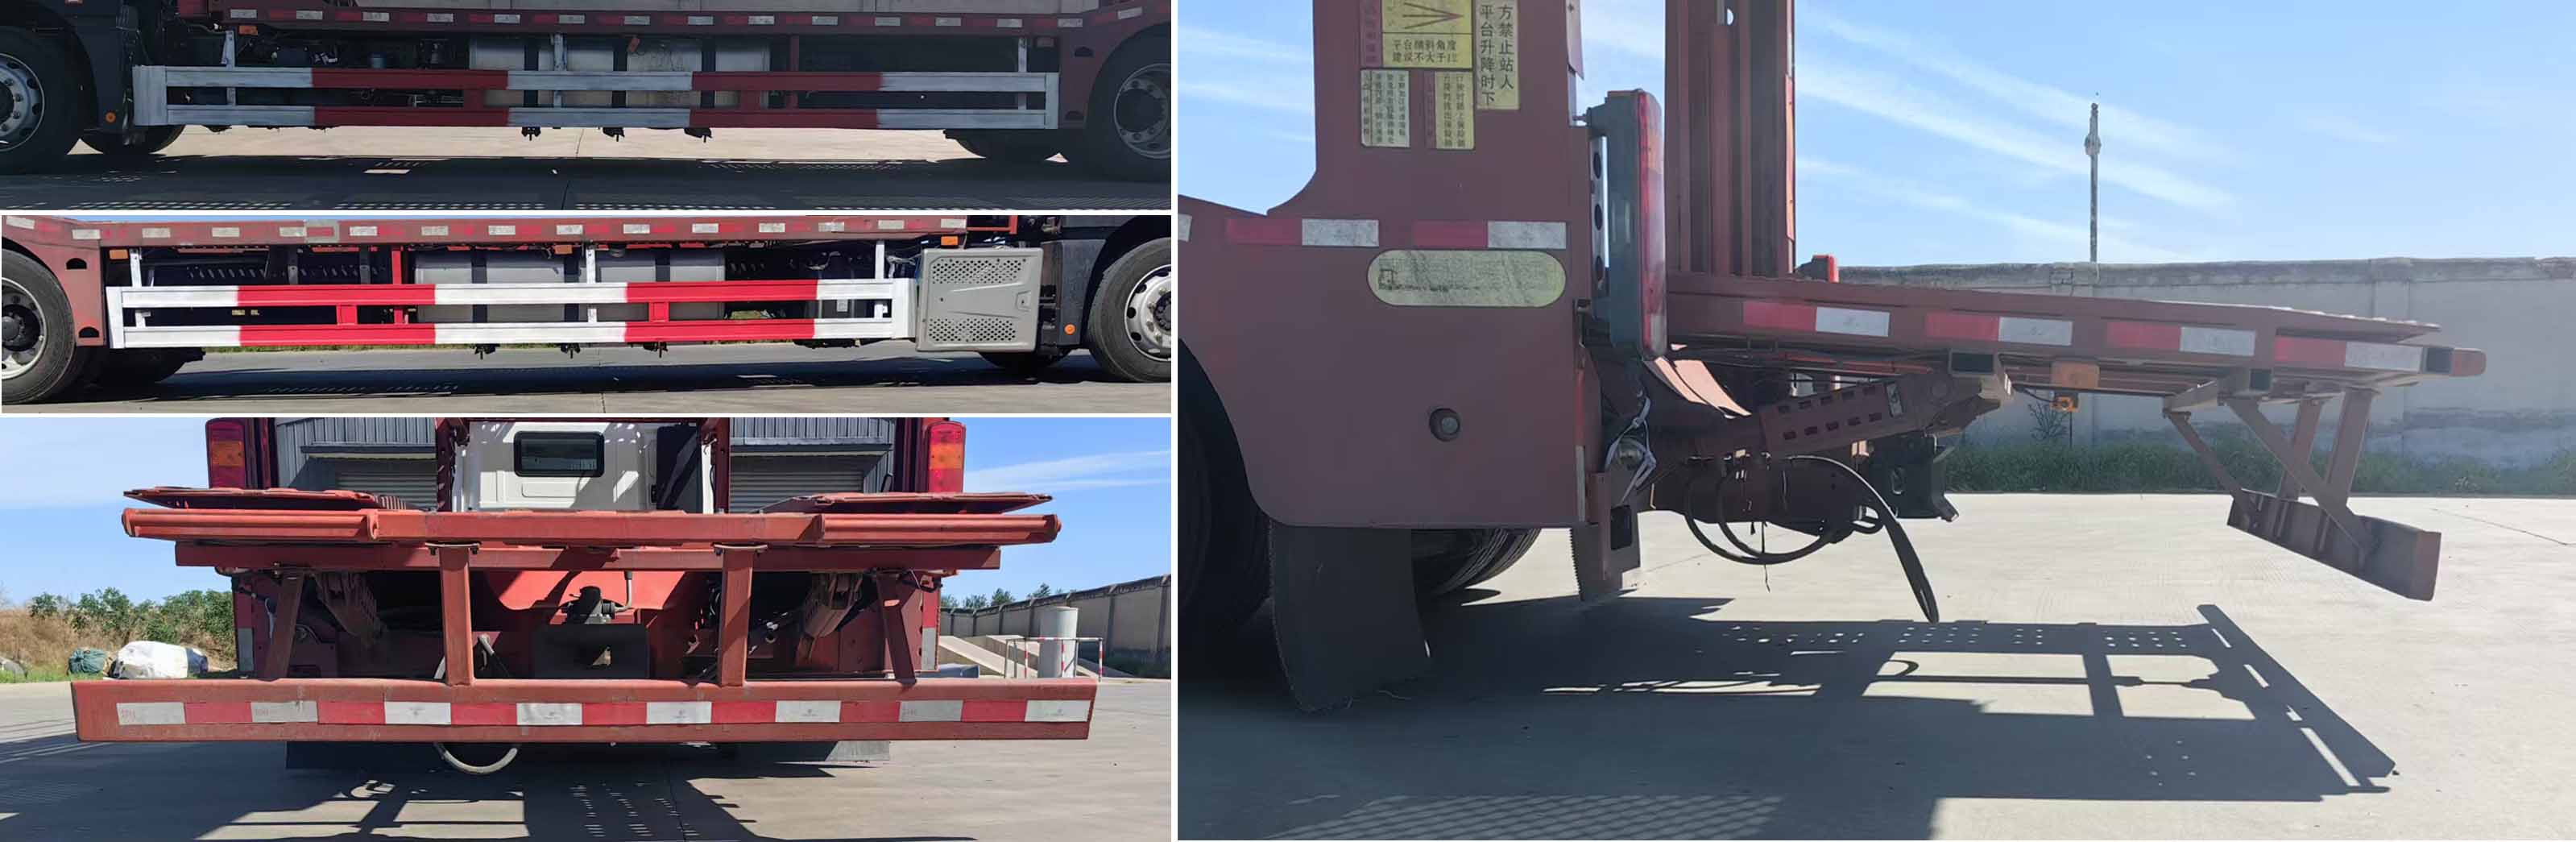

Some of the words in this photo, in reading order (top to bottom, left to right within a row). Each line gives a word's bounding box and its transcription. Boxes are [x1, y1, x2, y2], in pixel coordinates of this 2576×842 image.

[1481, 5, 1496, 106] 平台升降时下
[1497, 3, 1514, 89] 方禁止站人
